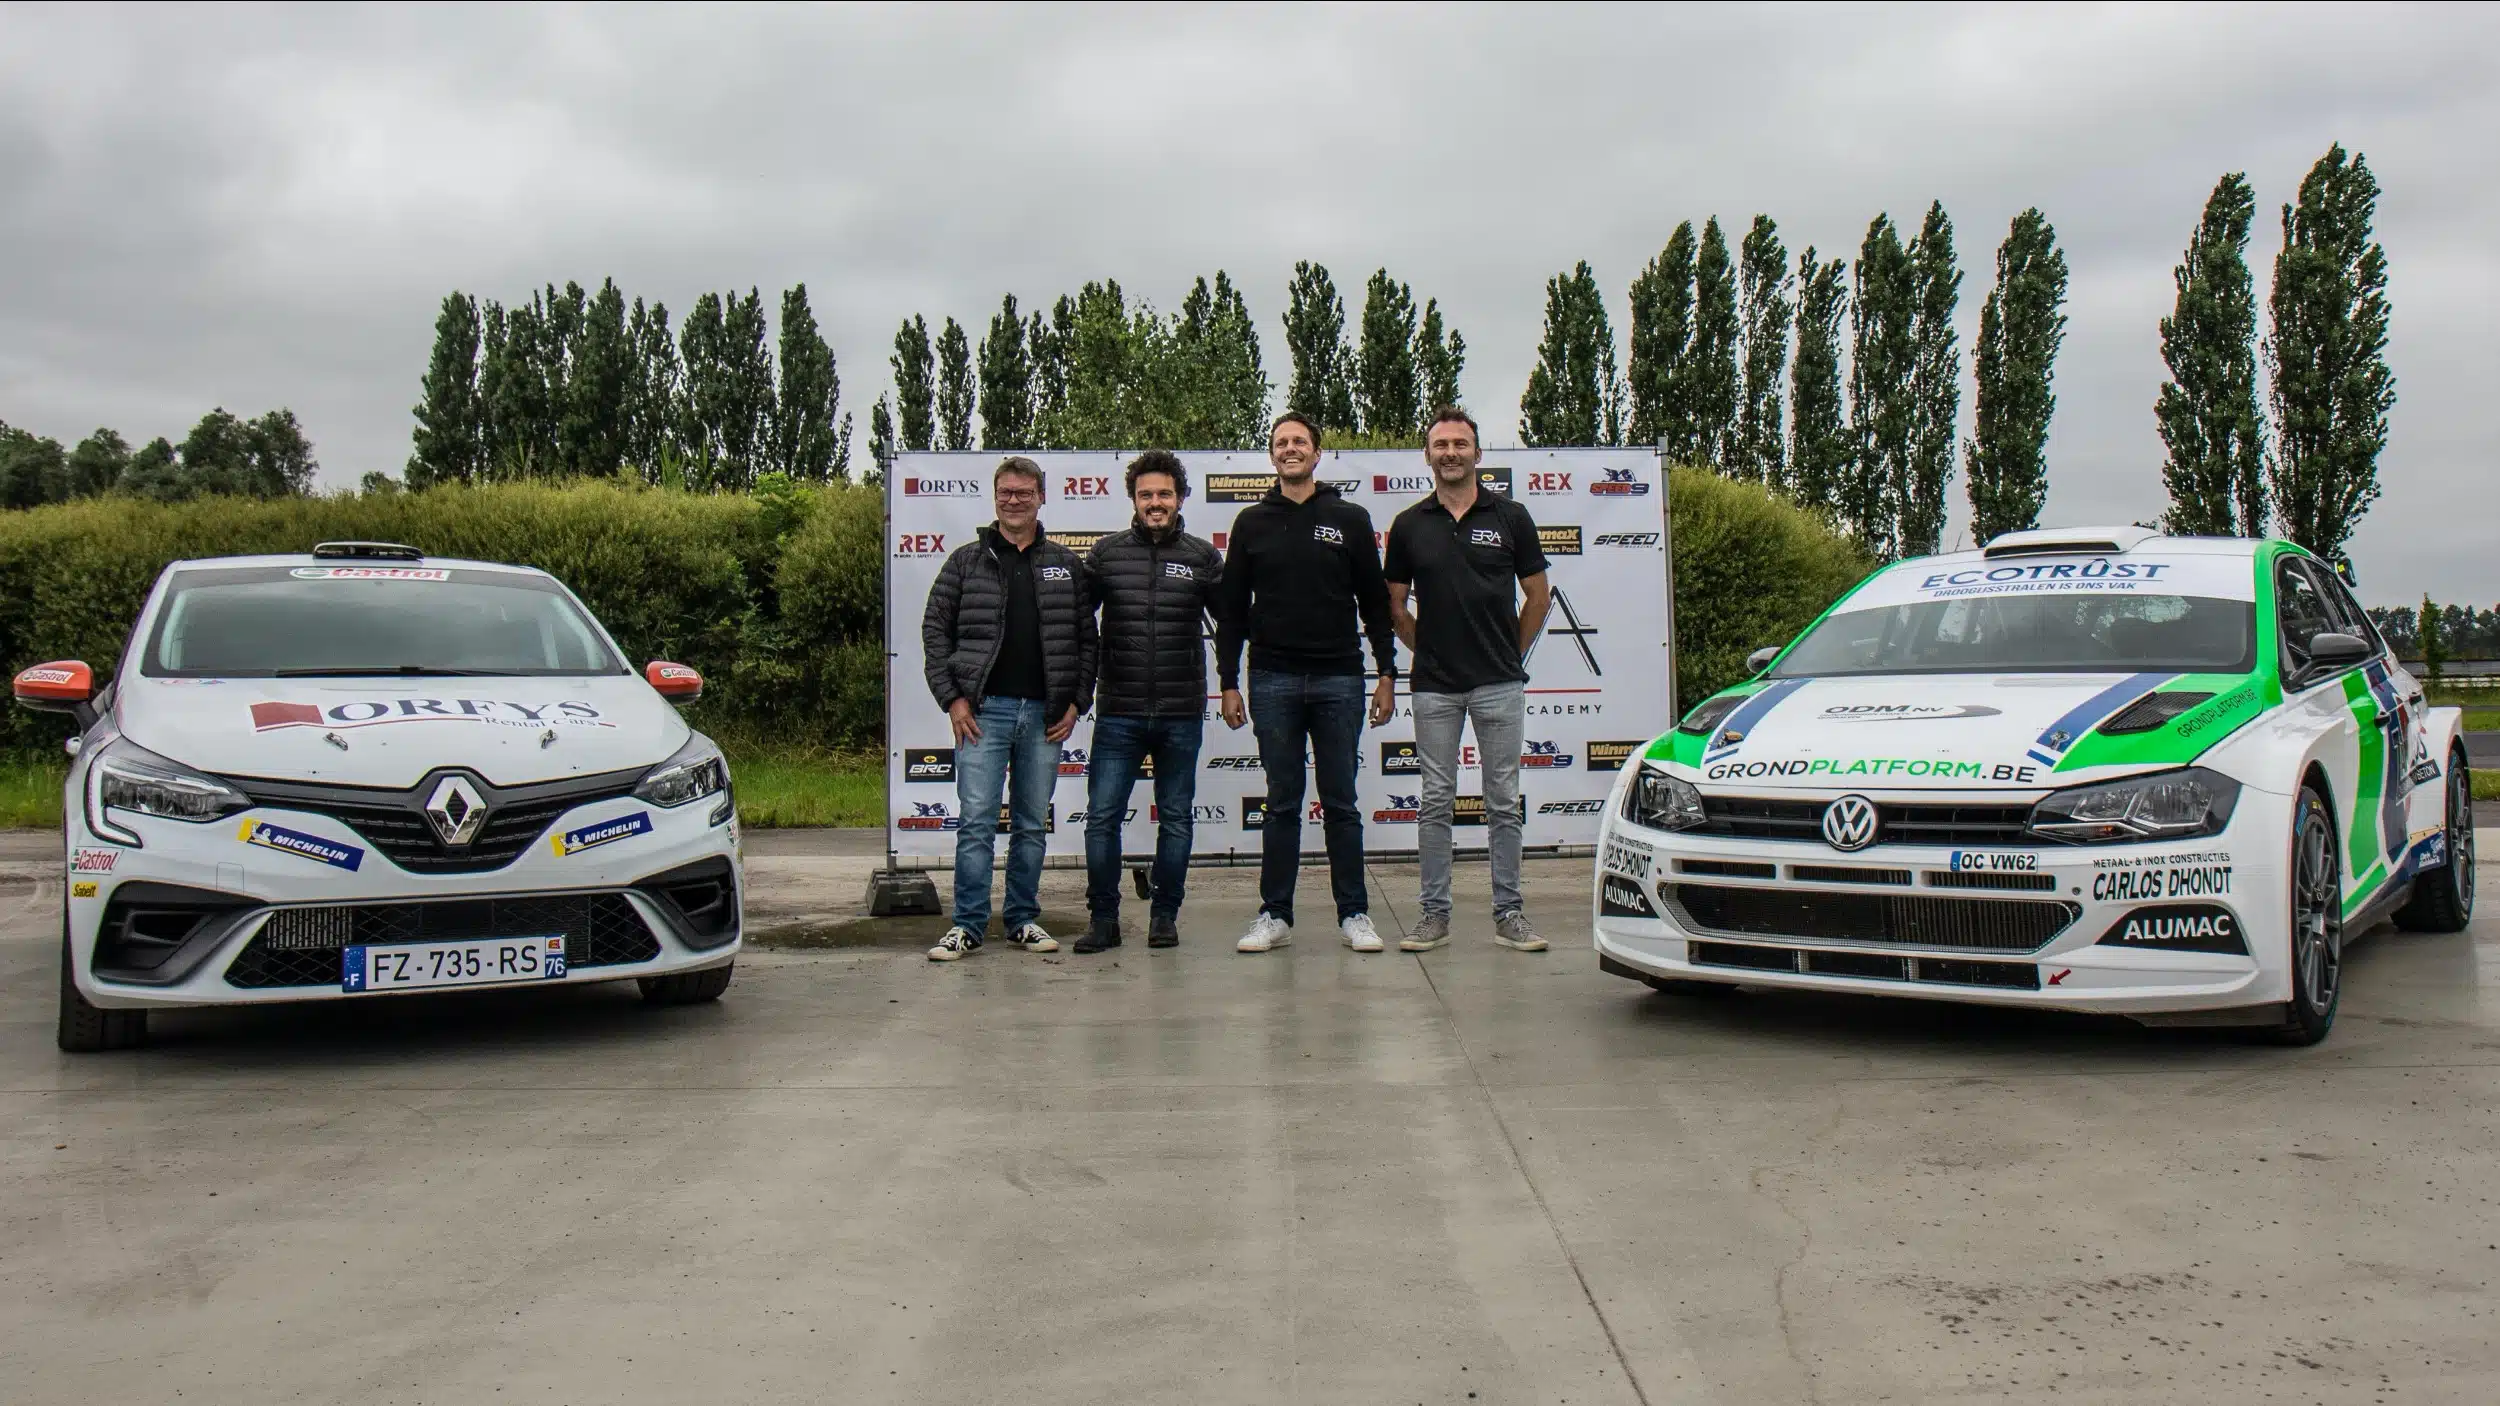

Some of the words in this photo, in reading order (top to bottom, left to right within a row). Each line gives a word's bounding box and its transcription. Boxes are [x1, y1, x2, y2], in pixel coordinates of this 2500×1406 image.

[920, 479, 980, 494] ORFYS
[1064, 477, 1110, 495] REX
[1388, 476, 1435, 490] ORFY
[1481, 482, 1509, 491] RC
[1528, 472, 1573, 491] REX
[1234, 493, 1258, 501] Brake
[899, 534, 946, 553] REX
[327, 566, 445, 581] Castrol
[2058, 581, 2072, 590] IS
[2075, 581, 2105, 590] ONS
[2107, 581, 2137, 590] VAK
[31, 671, 71, 684] Castrol
[327, 698, 601, 722] ORFYS
[1526, 704, 1602, 715] CADEMY
[1824, 704, 1912, 714] ODM
[483, 717, 546, 728] Rental
[553, 717, 597, 728] Cars
[908, 763, 952, 774] BRC
[1206, 757, 1264, 769] SPEE
[1707, 758, 2037, 784] GRONDPLATFORM.BE
[1193, 805, 1225, 819] FYS
[584, 819, 641, 844] MICHELIN
[273, 832, 349, 862] MICHELIN
[77, 850, 118, 872] Castrol
[1961, 853, 1984, 869] OC
[1990, 854, 2036, 871] VW62
[2135, 858, 2142, 866] &
[2144, 855, 2166, 866] INOX
[2169, 853, 2230, 864] CONSTRUCTIES
[2093, 870, 2162, 901] CARLOS
[2168, 866, 2232, 896] DHONDT
[73, 884, 97, 899] Sabelt
[1605, 883, 1645, 912] ALUMAC
[2123, 914, 2231, 941] ALUMAC
[546, 956, 565, 975] 76
[350, 973, 360, 986] F
